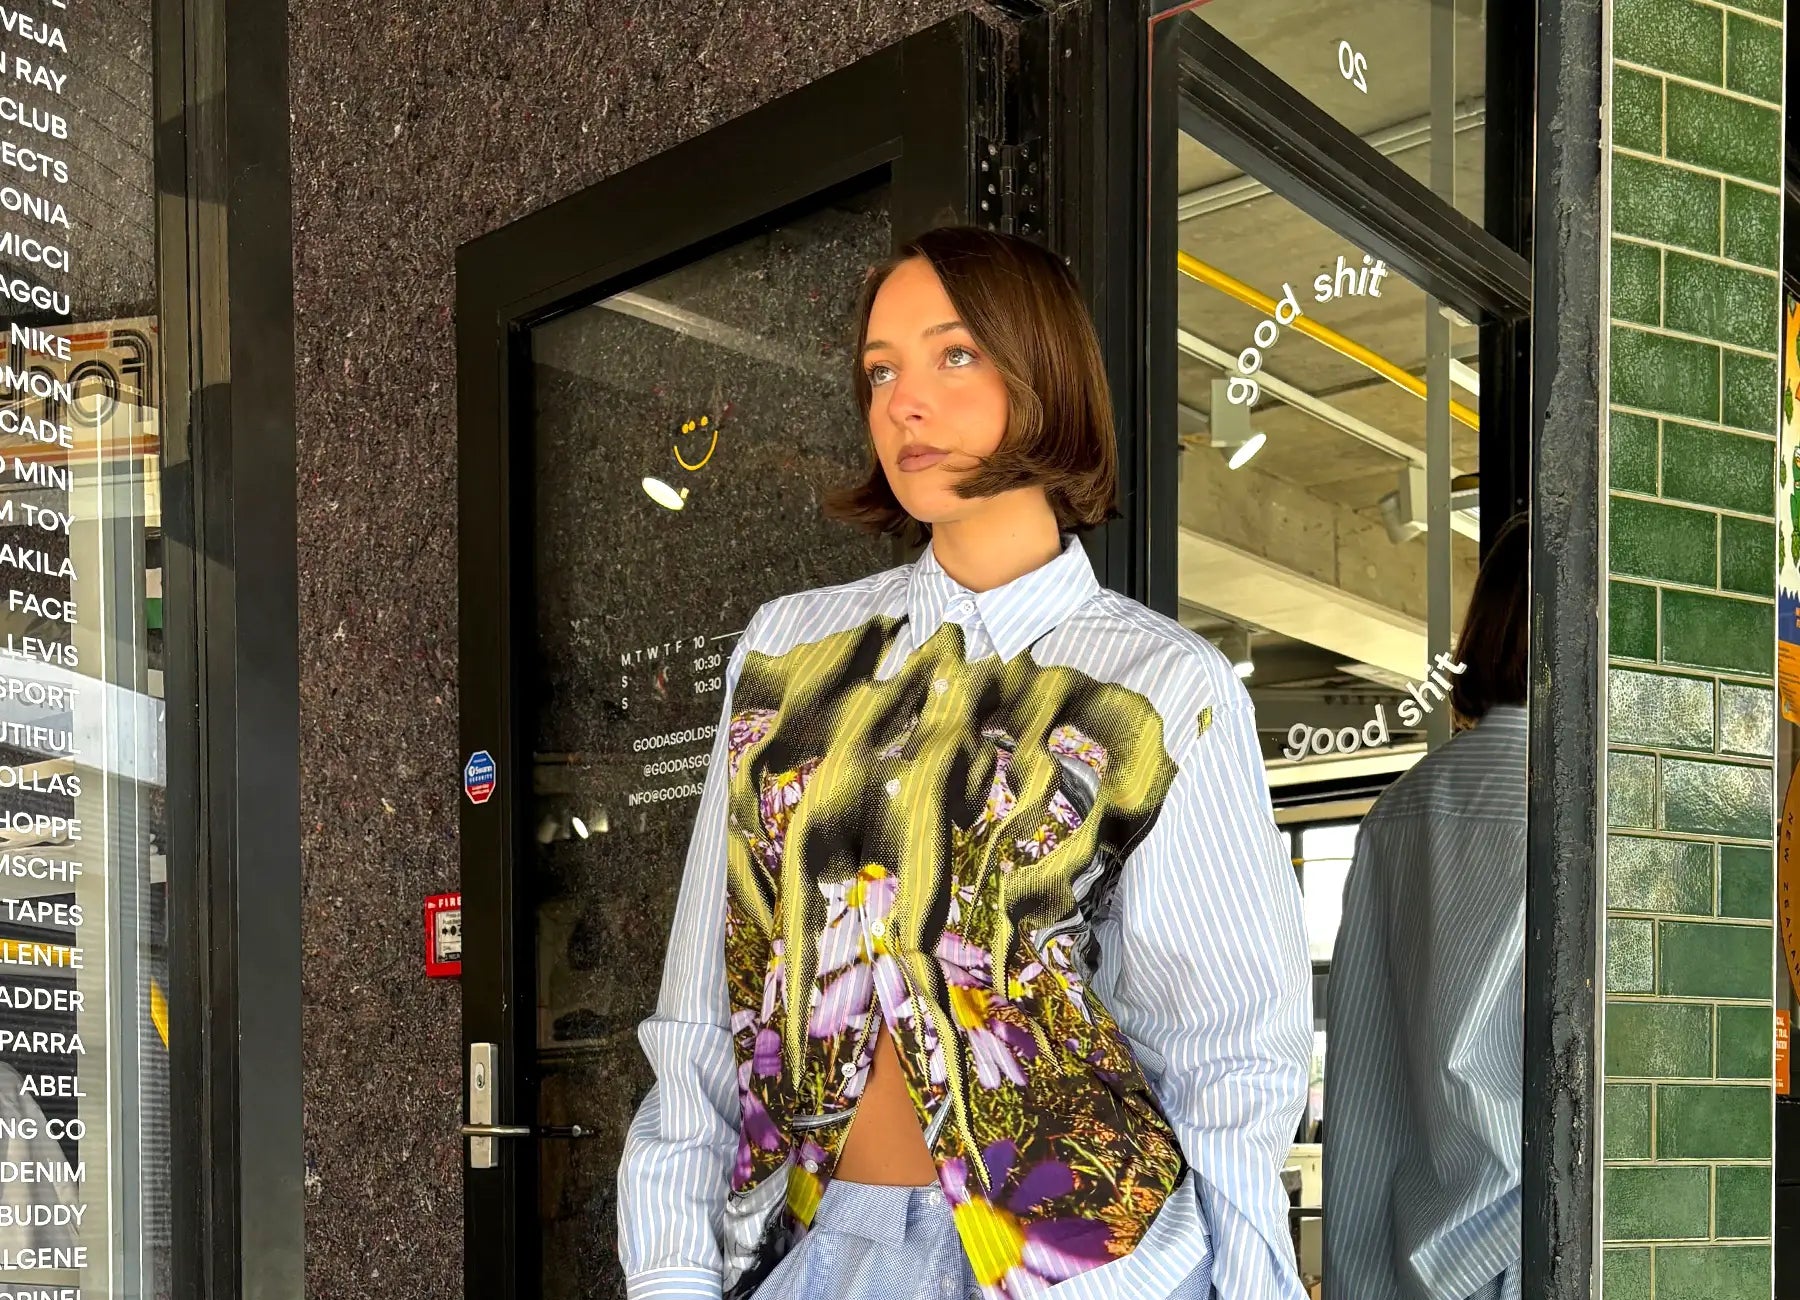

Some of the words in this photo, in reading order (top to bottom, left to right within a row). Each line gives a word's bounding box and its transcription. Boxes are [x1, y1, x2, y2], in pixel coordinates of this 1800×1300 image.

[0, 6, 67, 53] VEJA
[16, 57, 67, 94] RAY
[0, 97, 68, 139] CLUB
[2, 141, 69, 184] ECTS
[1, 187, 70, 229] ONIA
[11, 322, 72, 361] NIKE
[1227, 283, 1303, 406] good
[1313, 254, 1387, 303] shit
[0, 409, 73, 448] CADE
[15, 457, 74, 493] MINI
[21, 502, 76, 536] TOY
[0, 543, 77, 581] AKILA
[9, 589, 78, 624] FACE
[7, 633, 79, 667] LEVIS
[621, 653, 631, 667] M
[636, 650, 642, 662] T
[647, 645, 658, 660] W
[664, 643, 670, 656] T
[675, 640, 682, 653] F
[693, 635, 705, 650] 10
[621, 675, 628, 688] S
[693, 654, 721, 671] 10:30
[621, 697, 628, 710] S
[693, 677, 722, 694] 10:30
[1283, 703, 1390, 762] good
[1397, 651, 1467, 727] shit
[2, 899, 84, 927] TAPES
[0, 941, 84, 969] LENTE
[0, 1030, 86, 1055] PARRA
[19, 1074, 86, 1097] ABEL
[0, 1117, 38, 1140] NG
[45, 1118, 86, 1141] CO
[1, 1161, 86, 1183] DENIM
[0, 1204, 87, 1227] BUDDY
[0, 1246, 88, 1271] LGENE
